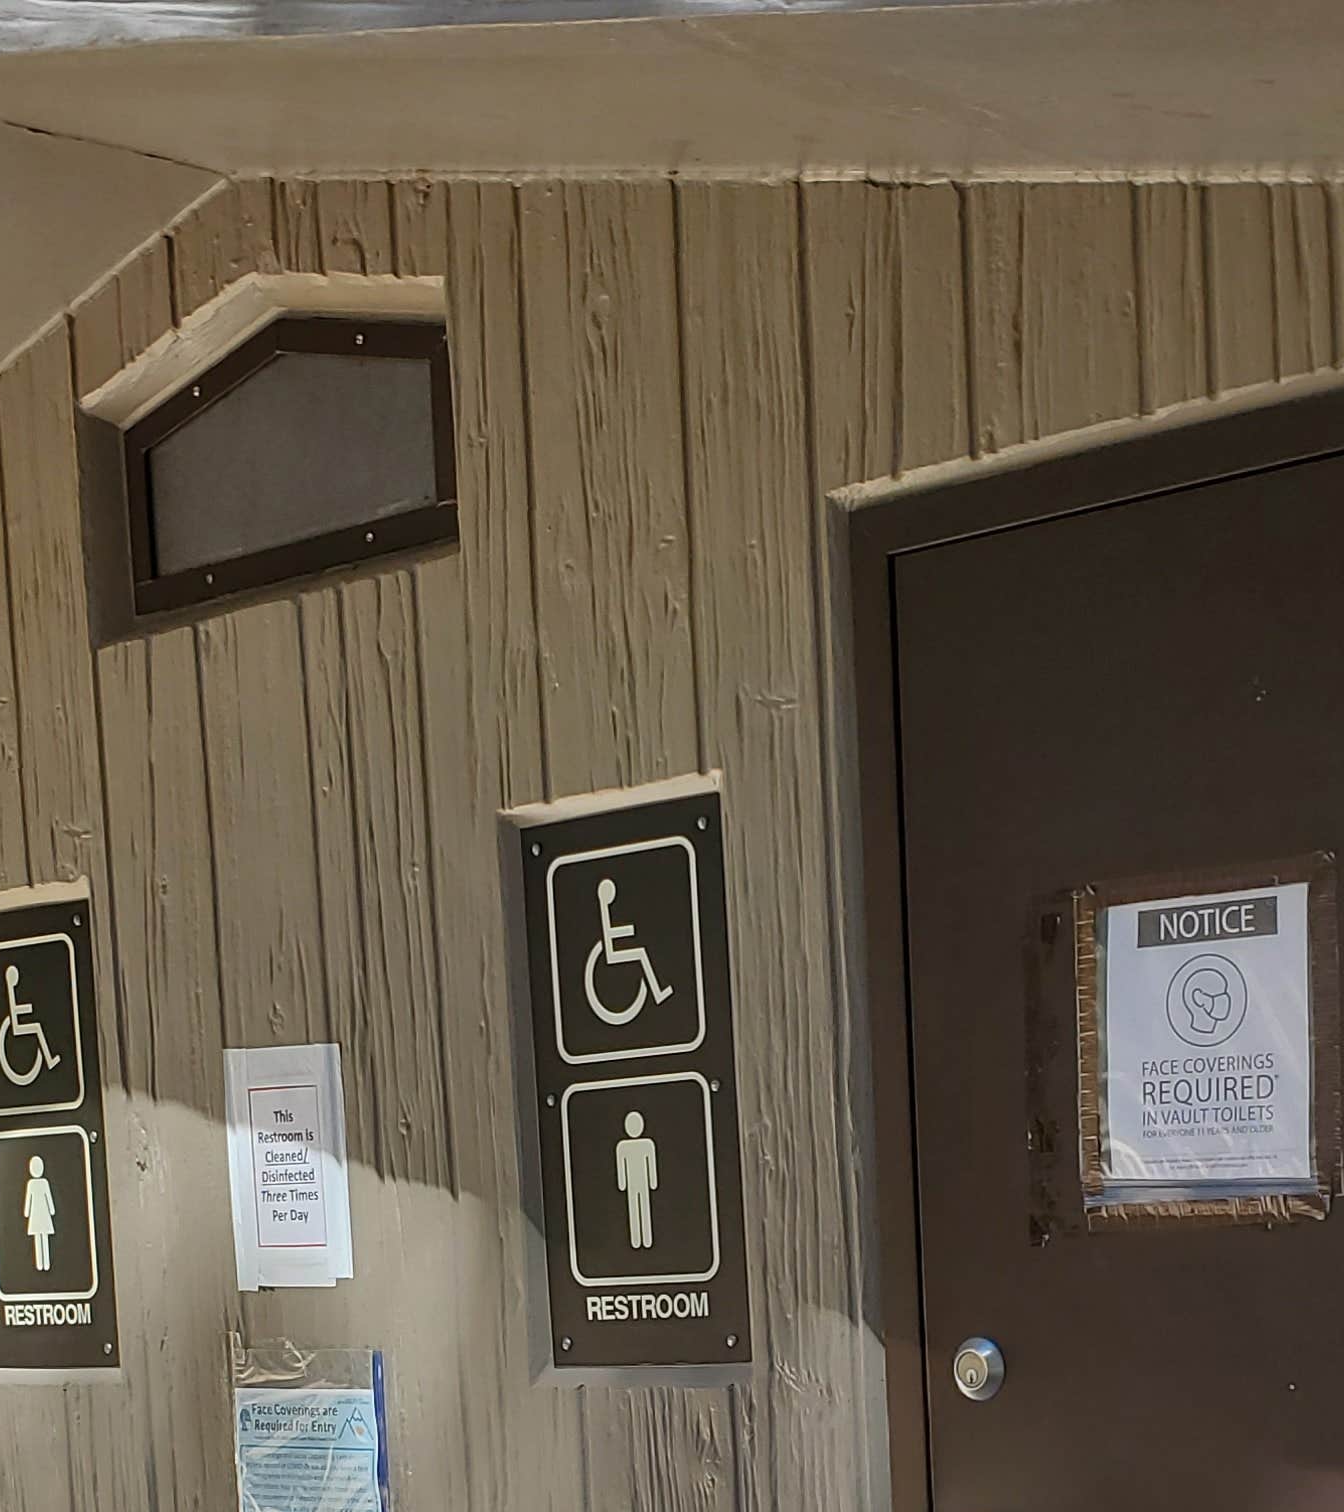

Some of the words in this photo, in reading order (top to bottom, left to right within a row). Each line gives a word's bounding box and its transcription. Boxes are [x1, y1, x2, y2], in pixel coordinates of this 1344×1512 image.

[1159, 903, 1256, 941] NOTICE
[1142, 1058, 1179, 1077] FACE
[1182, 1053, 1274, 1074] COVERINGS
[273, 1109, 294, 1123] This
[1142, 1111, 1157, 1126] IN
[1161, 1108, 1209, 1125] VAULT
[1211, 1105, 1274, 1122] TOILETS
[257, 1131, 303, 1143] Restroom
[265, 1147, 309, 1163] Cleaned/
[261, 1168, 315, 1183] Disinfected
[261, 1190, 287, 1203] Three
[289, 1188, 319, 1202] Times
[272, 1209, 288, 1222] Per
[290, 1208, 309, 1224] Day
[586, 1291, 709, 1321] RESTROOM
[3, 1303, 92, 1326] RESTROOM
[251, 1403, 272, 1416] Face
[274, 1403, 321, 1417] Coverings
[322, 1406, 338, 1416] are
[254, 1419, 293, 1433] Required
[295, 1420, 308, 1432] for
[311, 1420, 336, 1435] Entry
